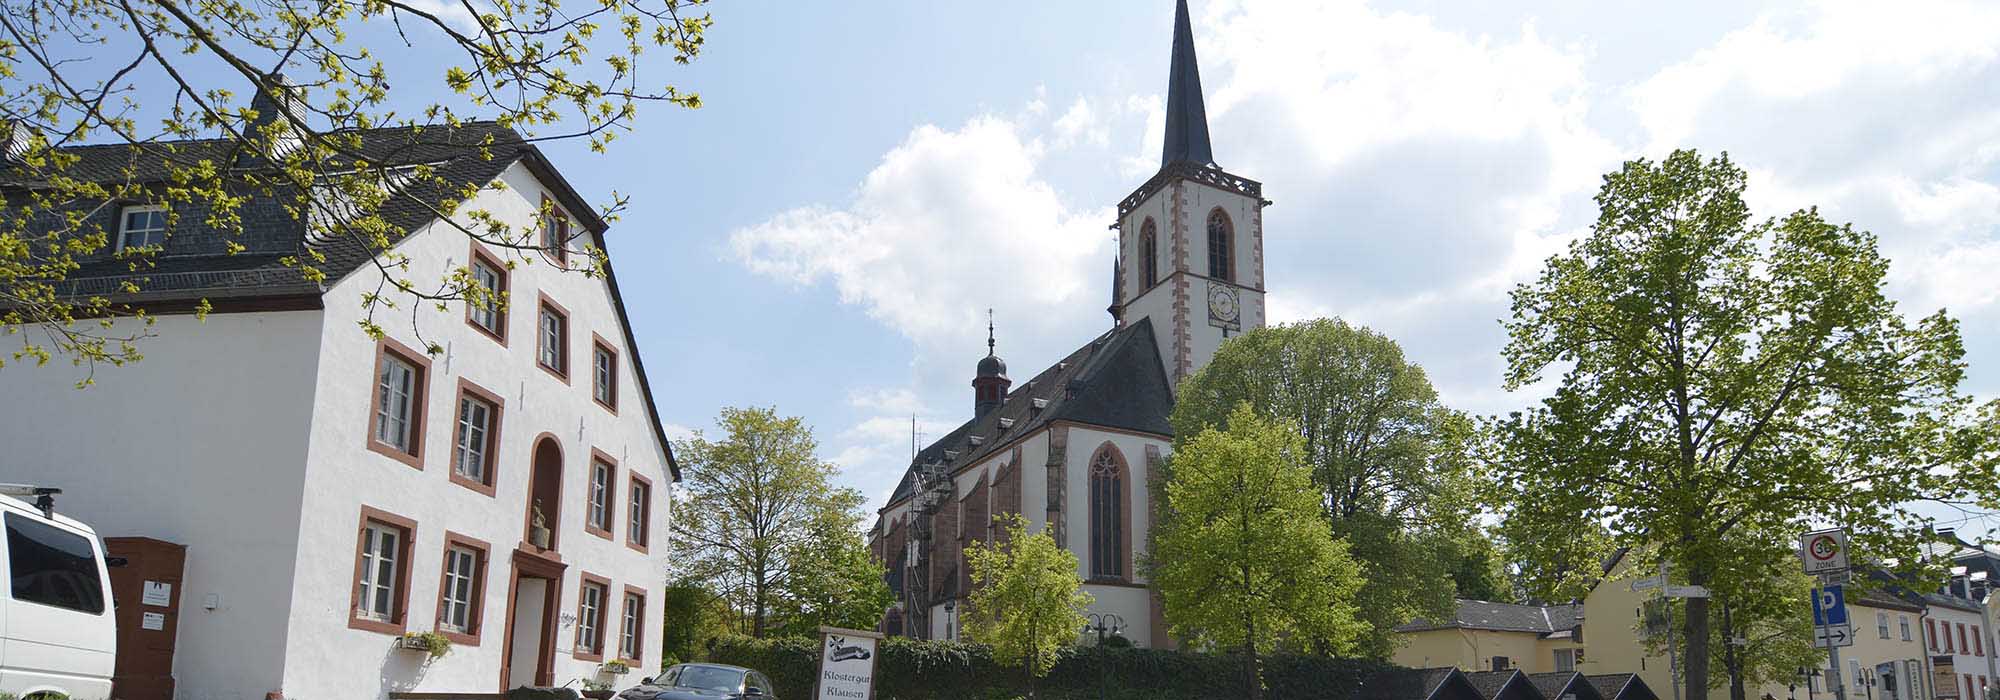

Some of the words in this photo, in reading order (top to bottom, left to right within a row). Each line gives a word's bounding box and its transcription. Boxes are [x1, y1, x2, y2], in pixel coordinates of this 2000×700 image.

[1815, 560, 1837, 569] ZONE
[1819, 591, 1836, 623] P
[824, 670, 870, 684] Klostergut
[827, 686, 864, 699] Klausen
